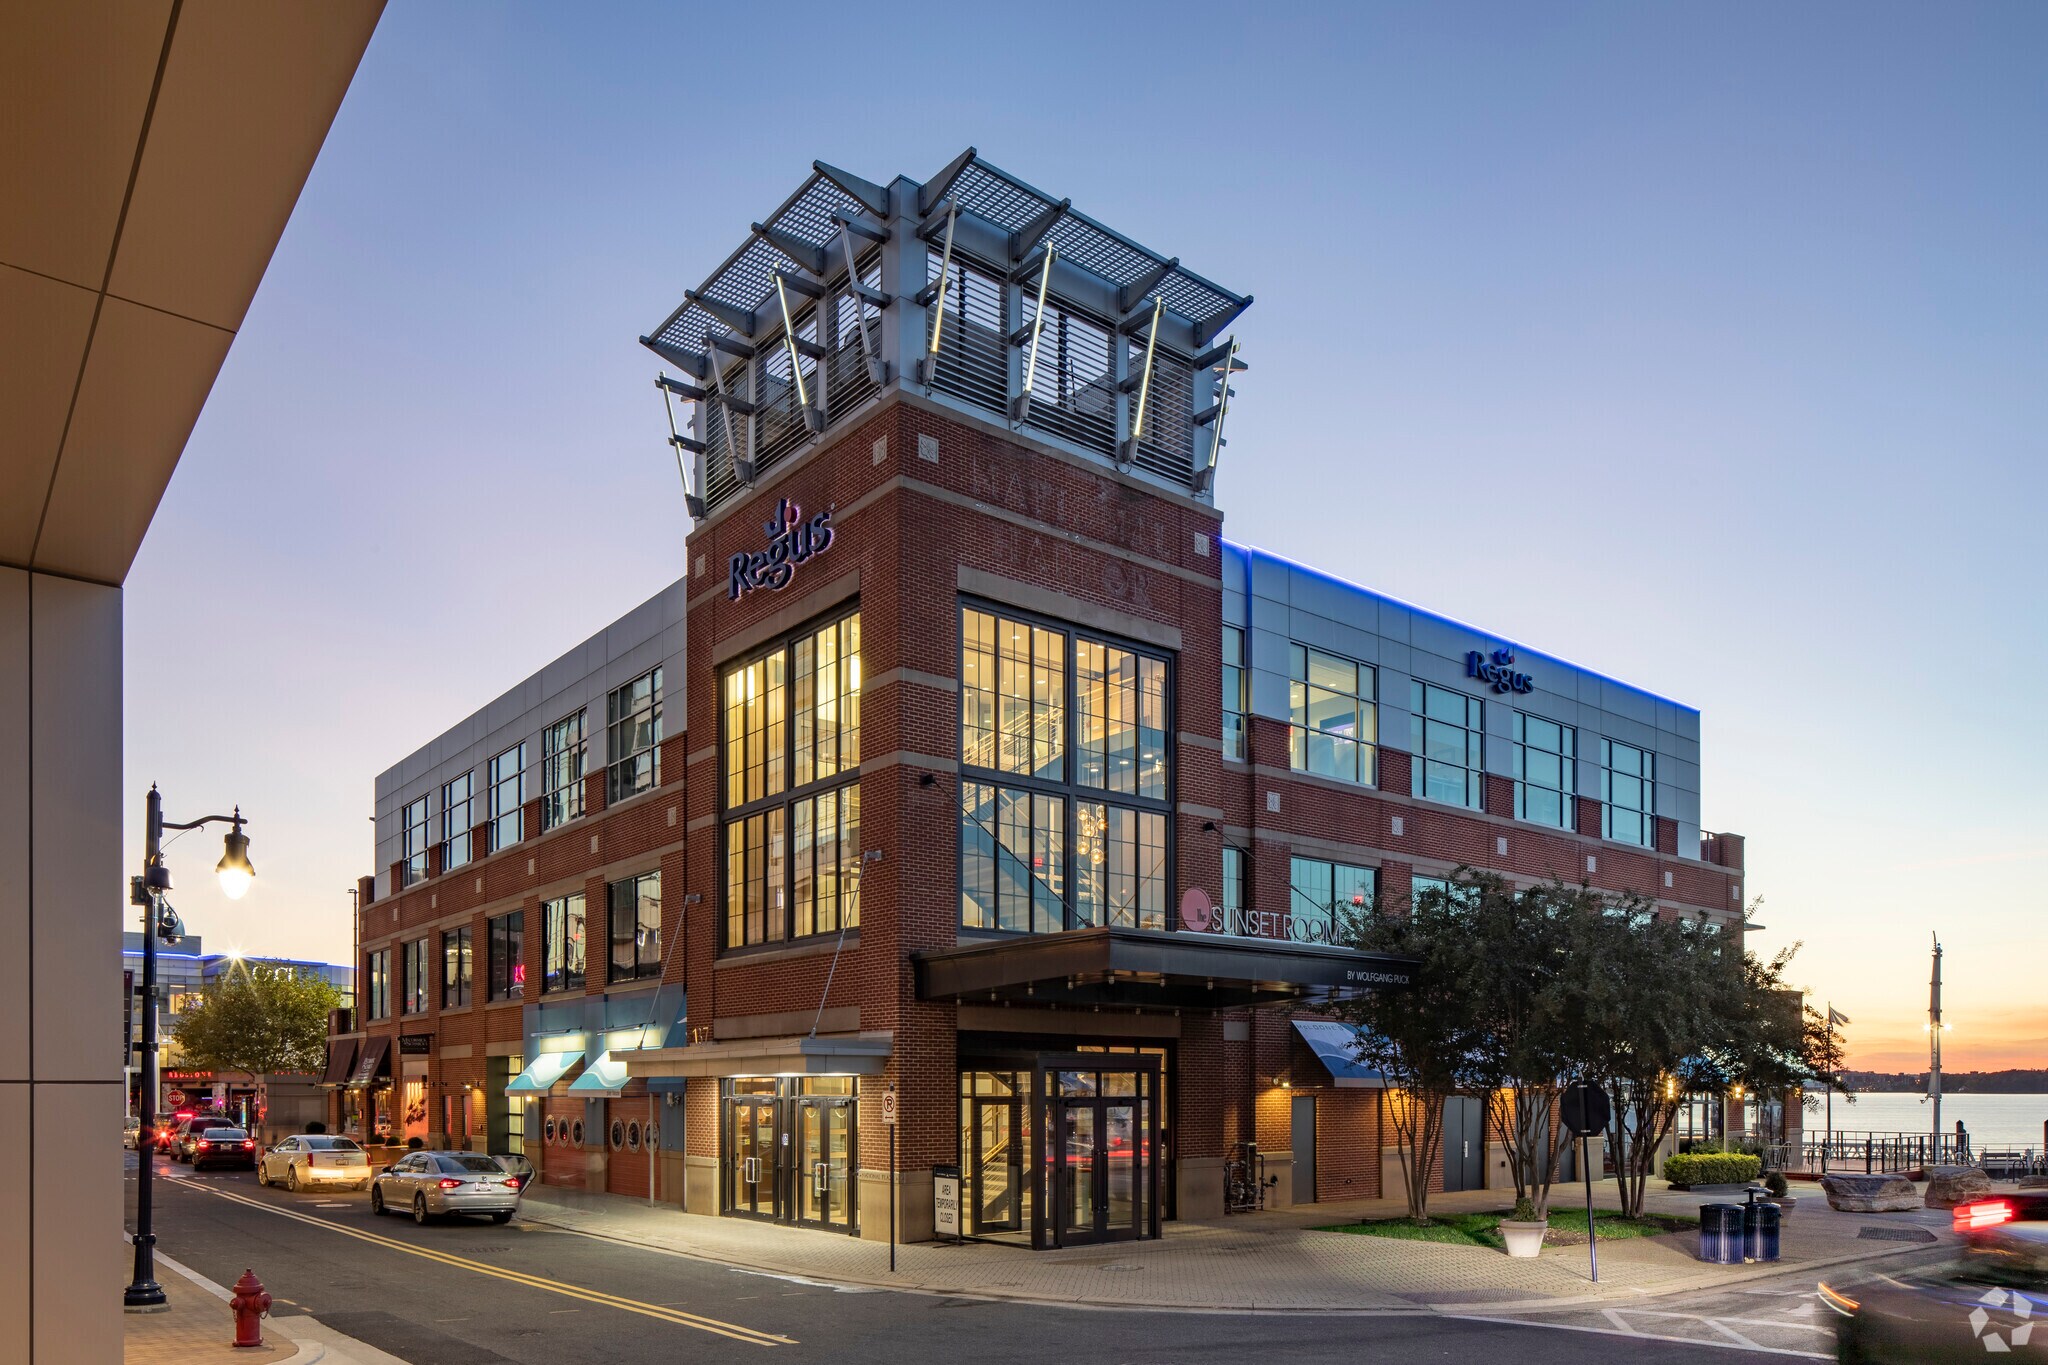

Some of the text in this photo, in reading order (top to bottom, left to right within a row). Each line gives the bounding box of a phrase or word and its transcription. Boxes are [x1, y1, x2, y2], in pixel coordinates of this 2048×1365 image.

[728, 511, 835, 600] Regus
[1467, 650, 1533, 694] Regus
[1211, 906, 1280, 937] SUNSET
[1283, 914, 1342, 945] ROOM
[1347, 970, 1410, 984] BY WOLFGANG PUCK
[942, 1184, 952, 1196] AREA
[936, 1197, 958, 1211] TEMPORARILY
[940, 1212, 954, 1224] CLOSED
